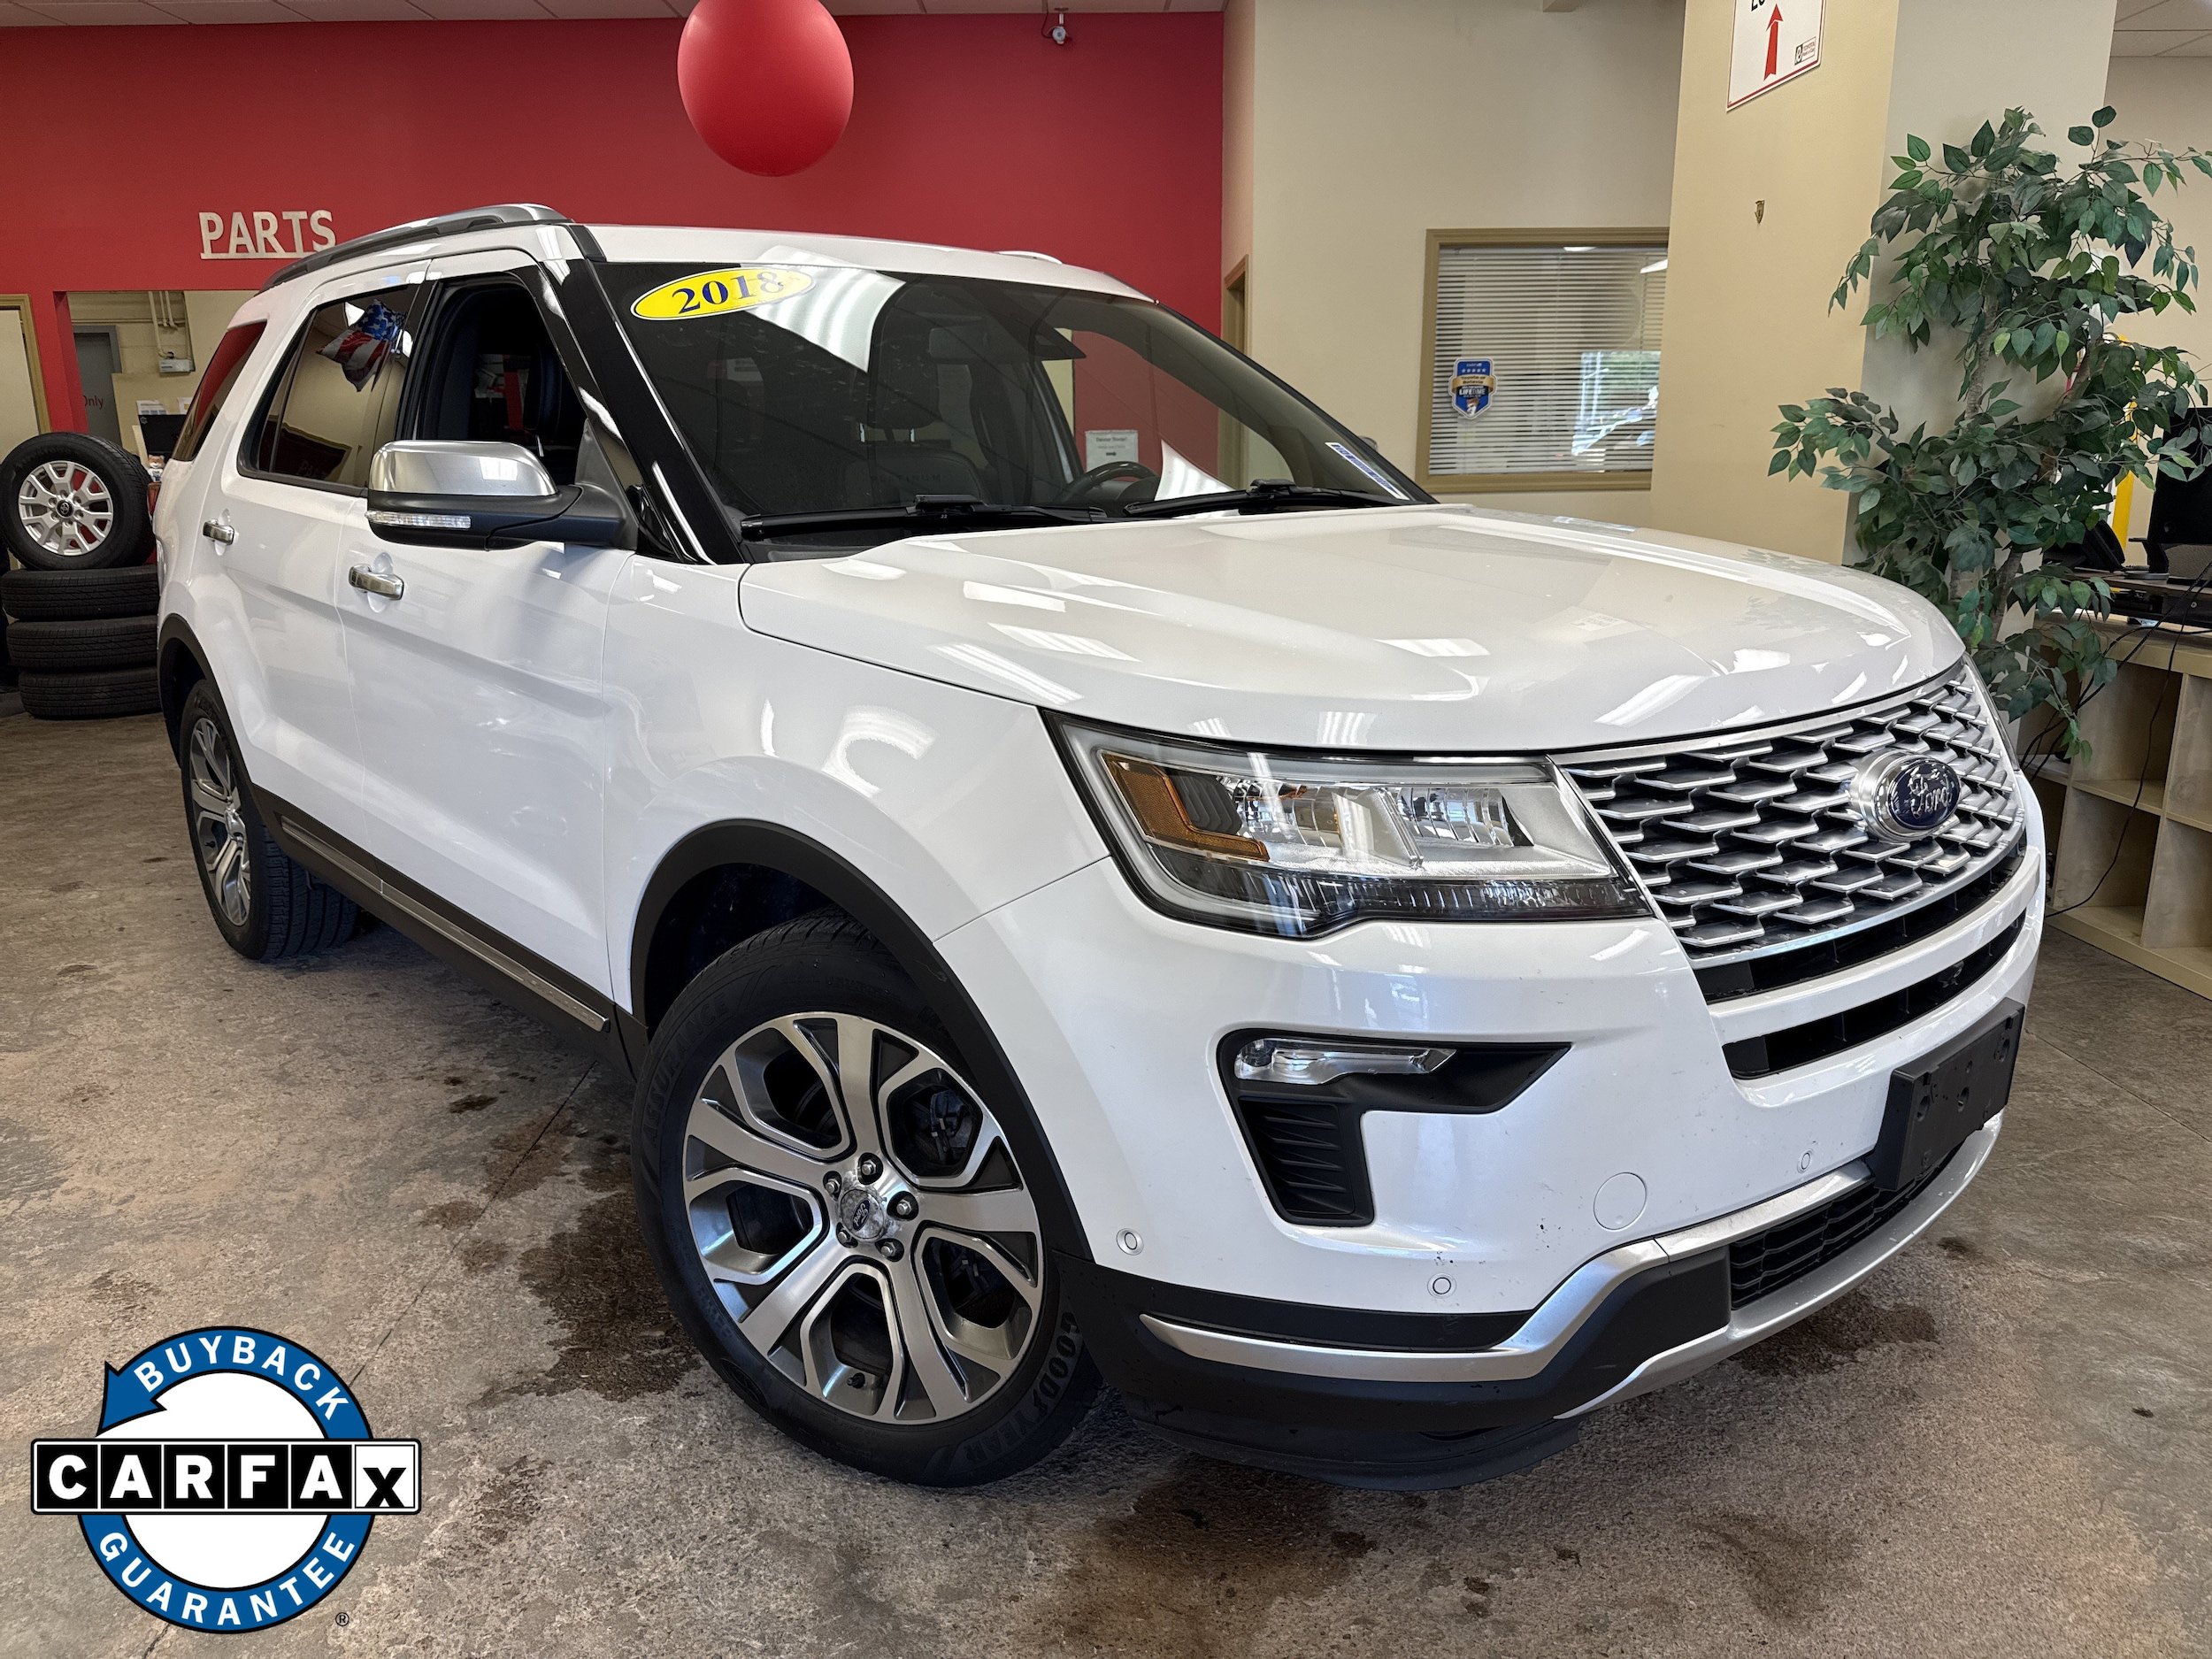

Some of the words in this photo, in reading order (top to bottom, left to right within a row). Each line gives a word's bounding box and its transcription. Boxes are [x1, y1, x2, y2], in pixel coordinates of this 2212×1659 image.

[198, 209, 337, 254] PARTS
[672, 271, 784, 315] 2018
[853, 1202, 869, 1227] Ford
